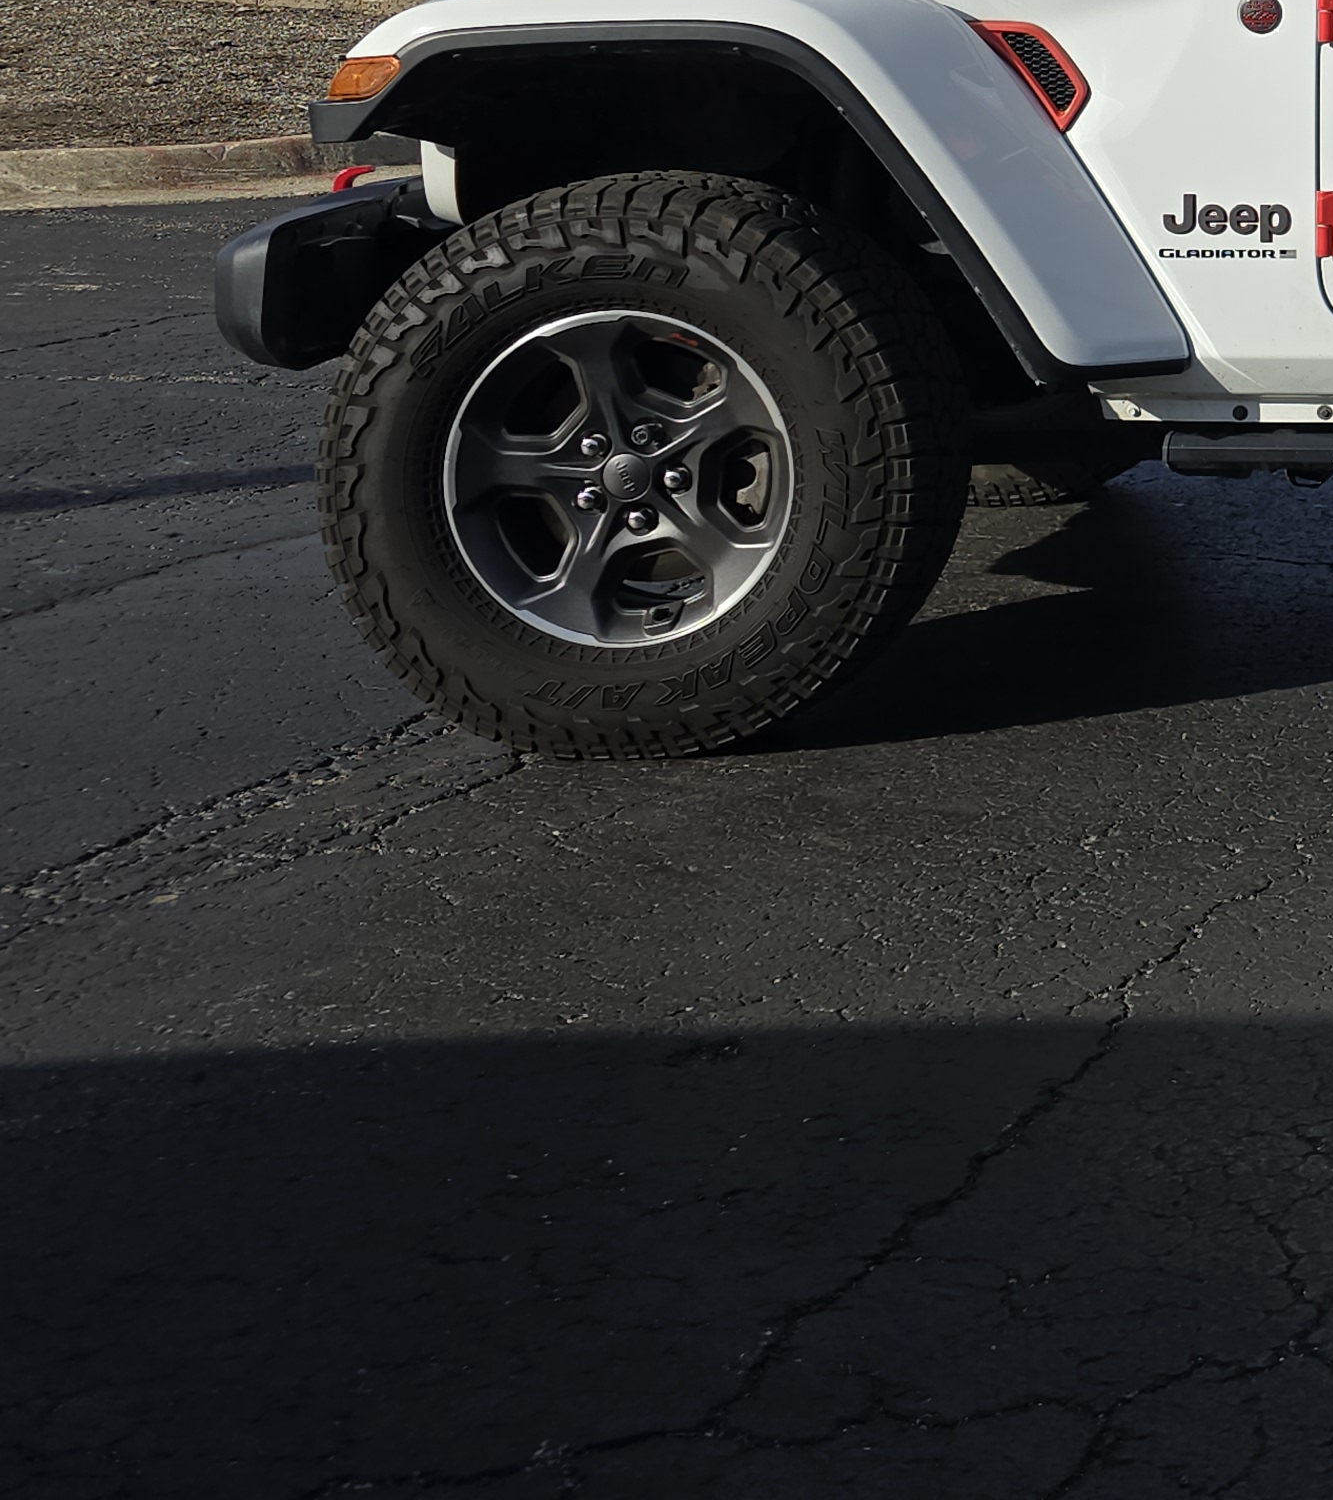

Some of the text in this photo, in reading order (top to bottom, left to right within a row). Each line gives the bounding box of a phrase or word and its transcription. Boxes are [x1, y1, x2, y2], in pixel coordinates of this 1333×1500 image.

[1162, 193, 1292, 243] Jeep
[1158, 248, 1277, 259] GLADIATOR
[614, 460, 636, 493] Jeep
[654, 426, 850, 707] WILDPEAK
